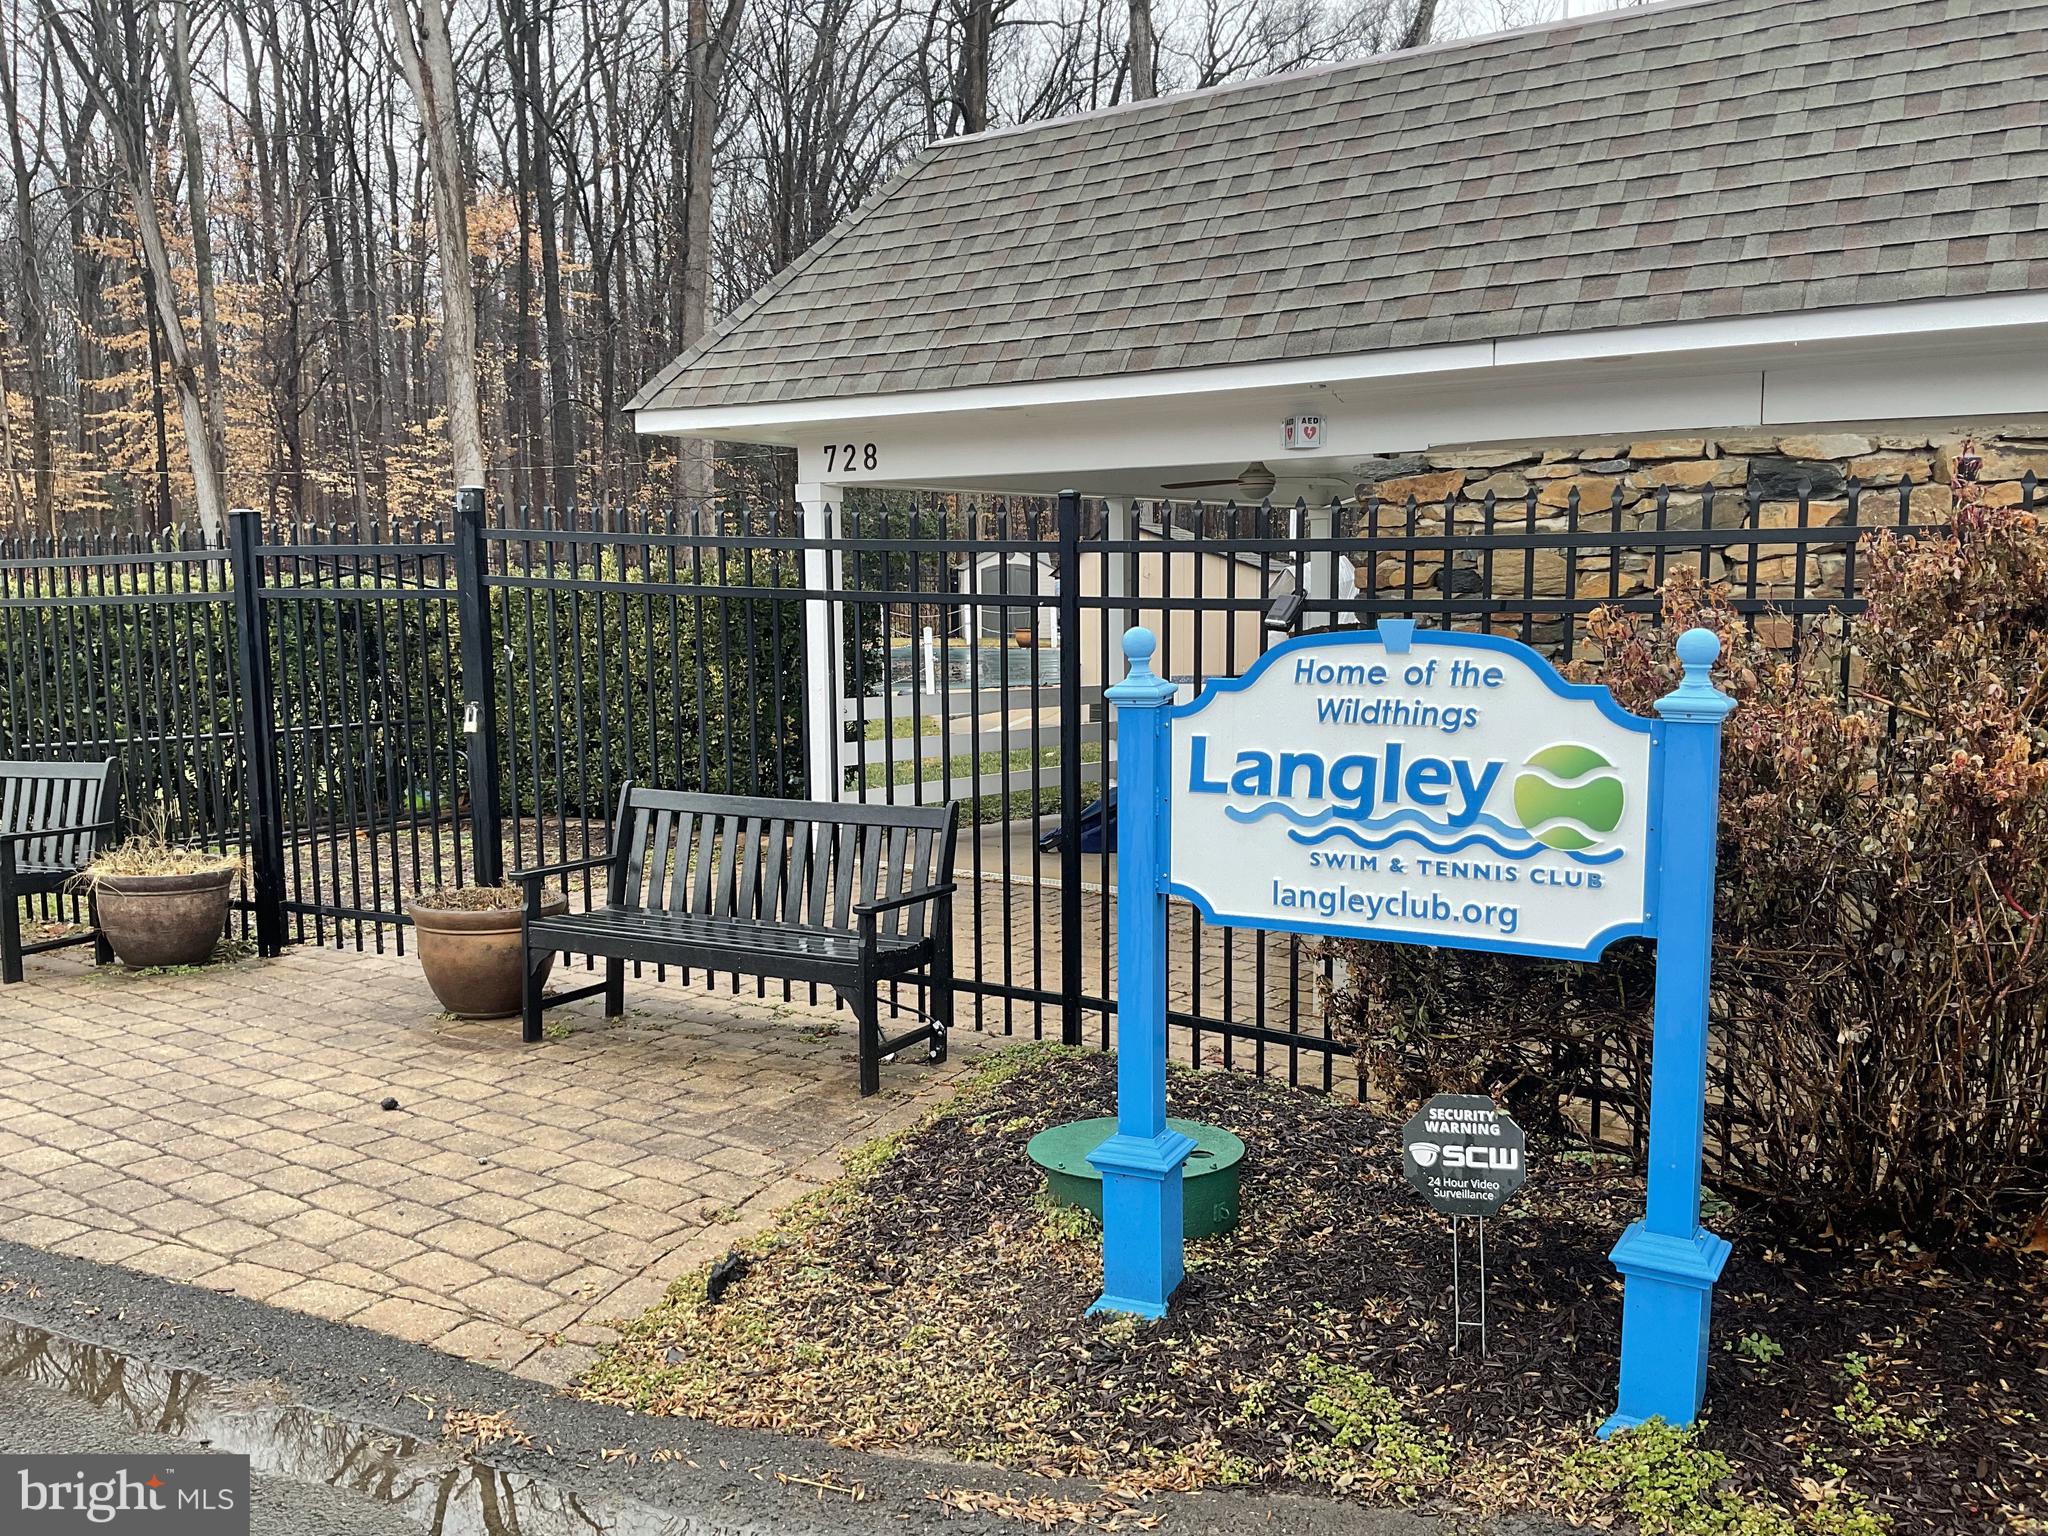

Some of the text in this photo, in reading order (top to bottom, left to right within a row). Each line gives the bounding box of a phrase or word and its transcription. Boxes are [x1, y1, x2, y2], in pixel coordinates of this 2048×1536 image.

[824, 443, 877, 472] 728
[1295, 659, 1504, 688] Home of the
[1317, 698, 1478, 733] Wildthings
[1189, 736, 1504, 827] Langley
[1309, 852, 1604, 889] SWIM & TENNIS CLUB
[1273, 880, 1518, 933] langleyclub.org
[1424, 1121, 1501, 1136] WARNING
[1429, 1108, 1495, 1122] SECURITY
[1442, 1145, 1519, 1170] SCW
[1427, 1176, 1500, 1190] 24 Hour Video
[1433, 1187, 1495, 1200] Surveillance
